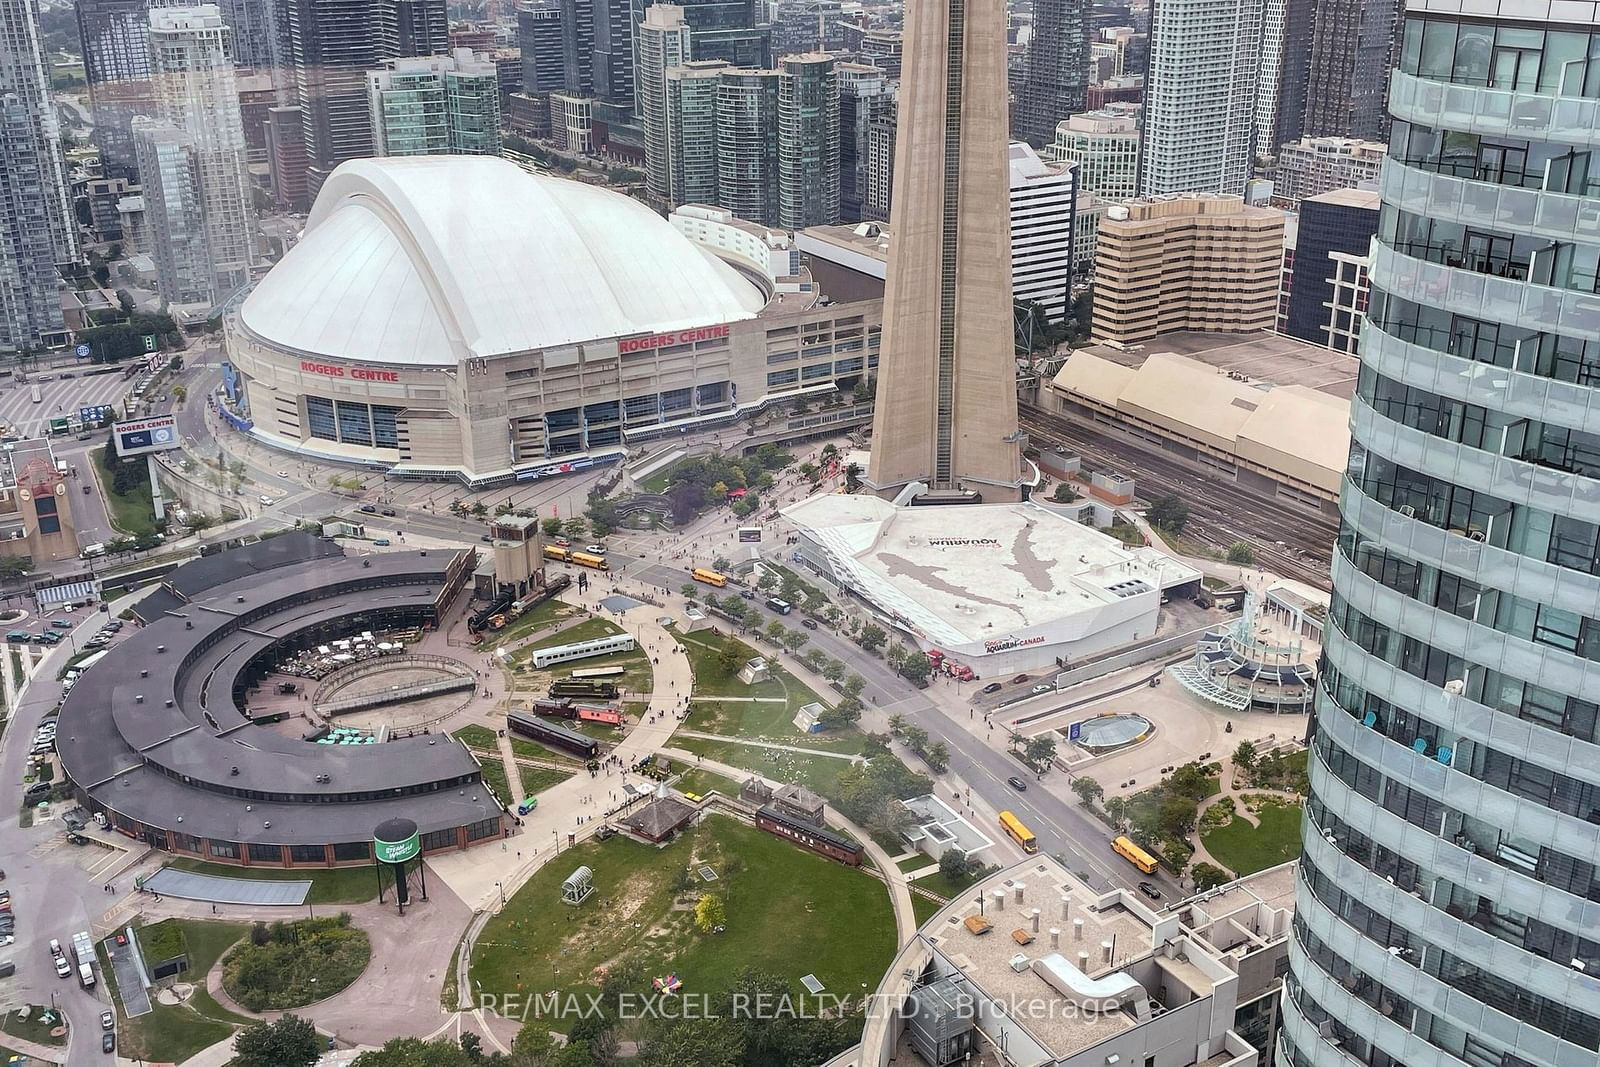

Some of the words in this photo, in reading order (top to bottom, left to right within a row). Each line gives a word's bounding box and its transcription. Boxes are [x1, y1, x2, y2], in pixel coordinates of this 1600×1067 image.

[619, 334, 675, 353] ROGERS
[680, 325, 730, 344] CENTRE
[300, 361, 345, 377] ROGERS
[350, 368, 399, 382] CENTRE
[116, 423, 145, 433] ROGERS
[147, 419, 175, 428] CENTRE
[929, 538, 998, 546] AQUARIUM
